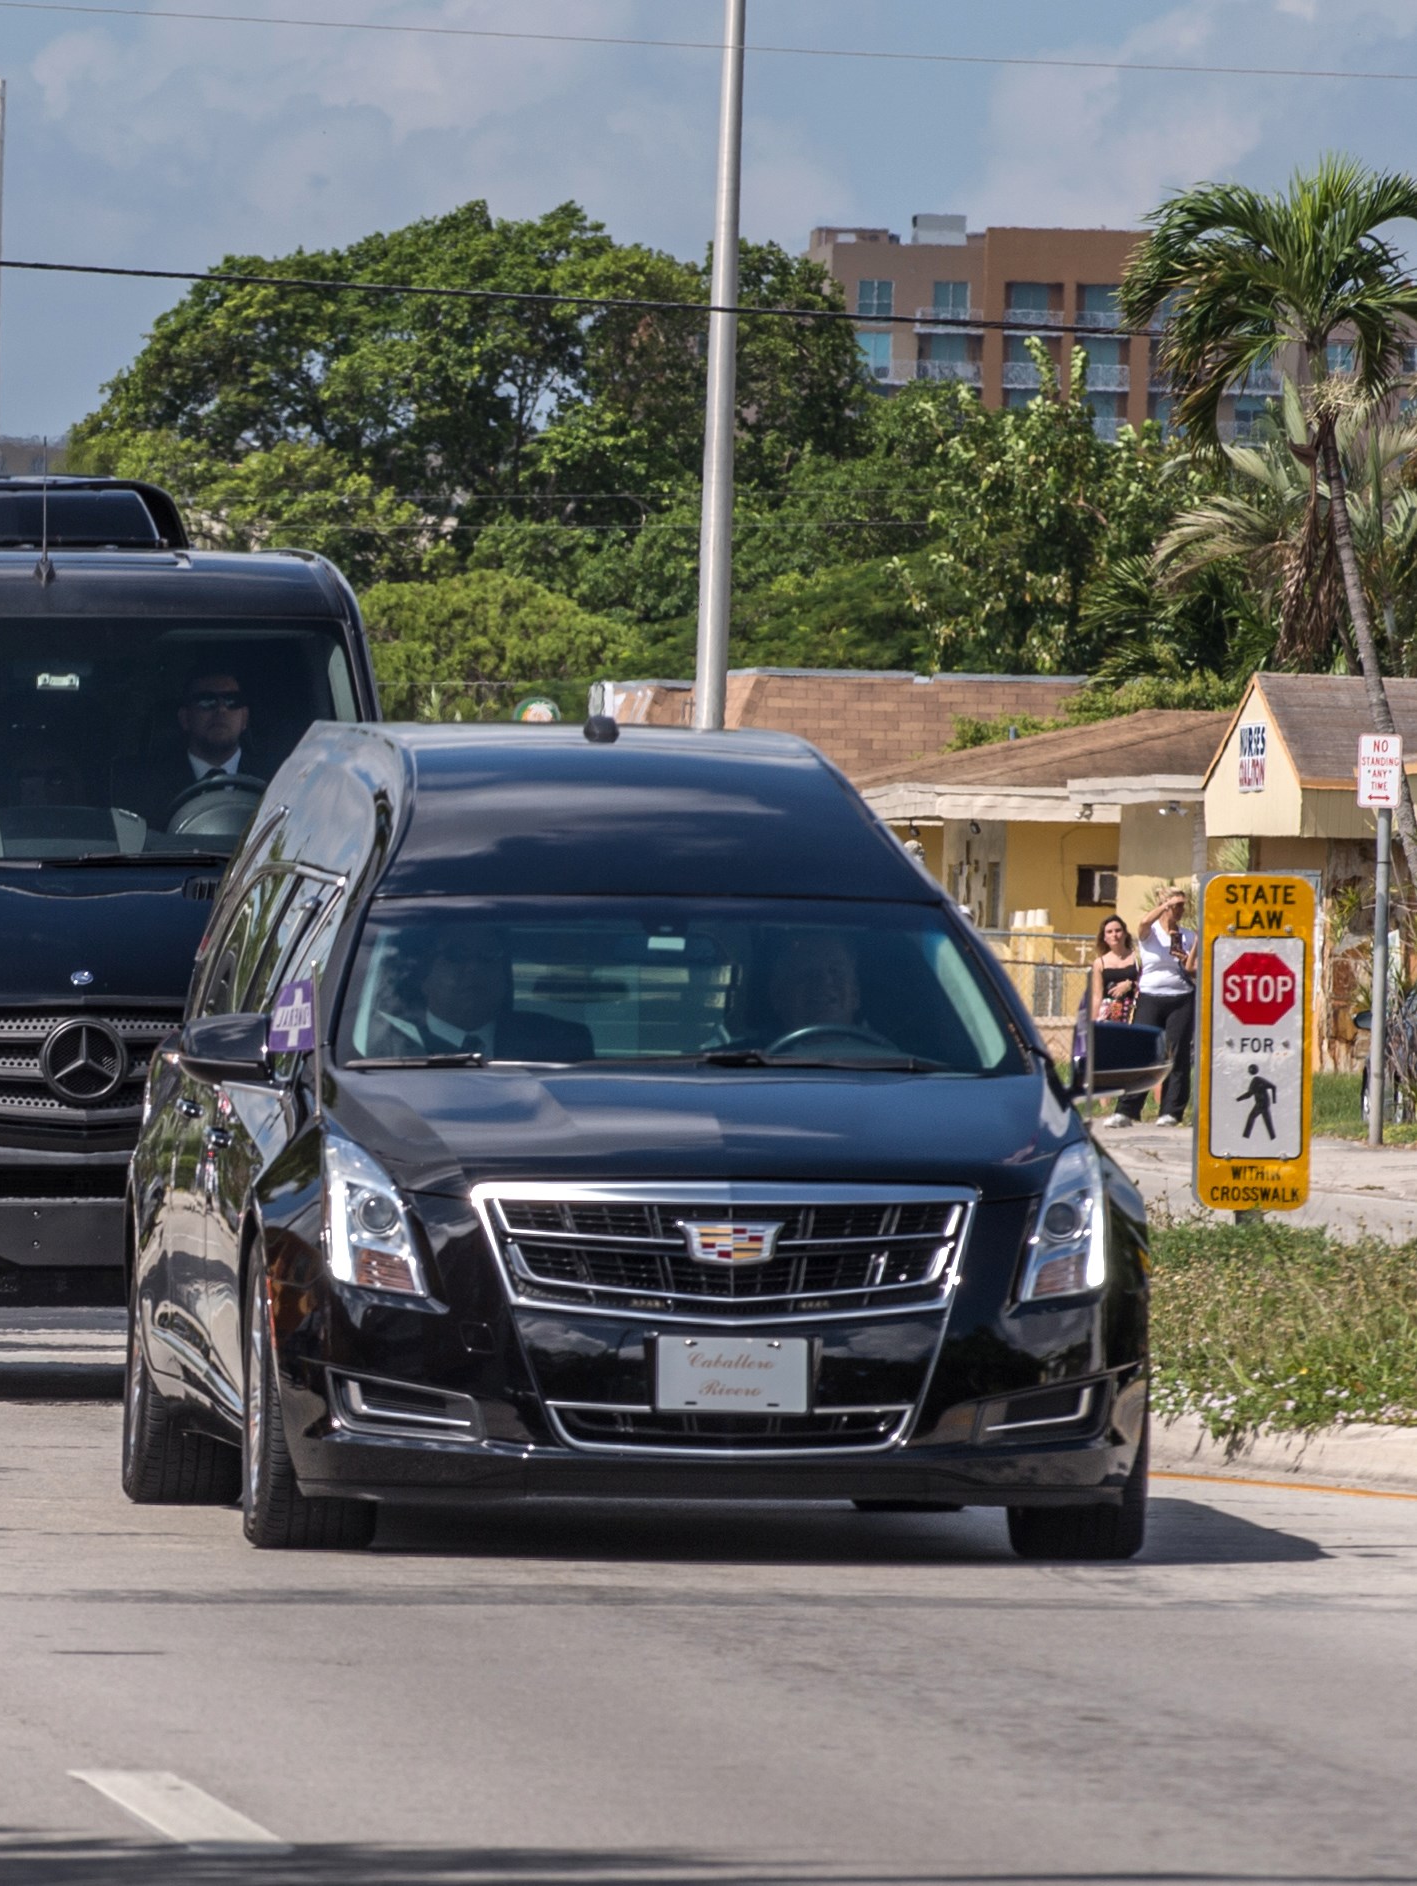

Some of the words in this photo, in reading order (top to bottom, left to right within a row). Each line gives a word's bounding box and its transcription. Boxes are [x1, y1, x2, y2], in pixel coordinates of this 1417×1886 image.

[1373, 739, 1389, 753] NO
[1361, 756, 1400, 767] STANDING
[1372, 769, 1388, 779] ANY
[1371, 781, 1388, 792] TIME
[1225, 884, 1296, 905] STATE
[1235, 910, 1284, 930] LAW
[1224, 974, 1293, 1003] STOP
[1240, 1037, 1274, 1053] FOR
[1210, 1185, 1301, 1203] CROSSWALK
[687, 1351, 776, 1370] Caballero
[698, 1379, 762, 1397] Rivero
